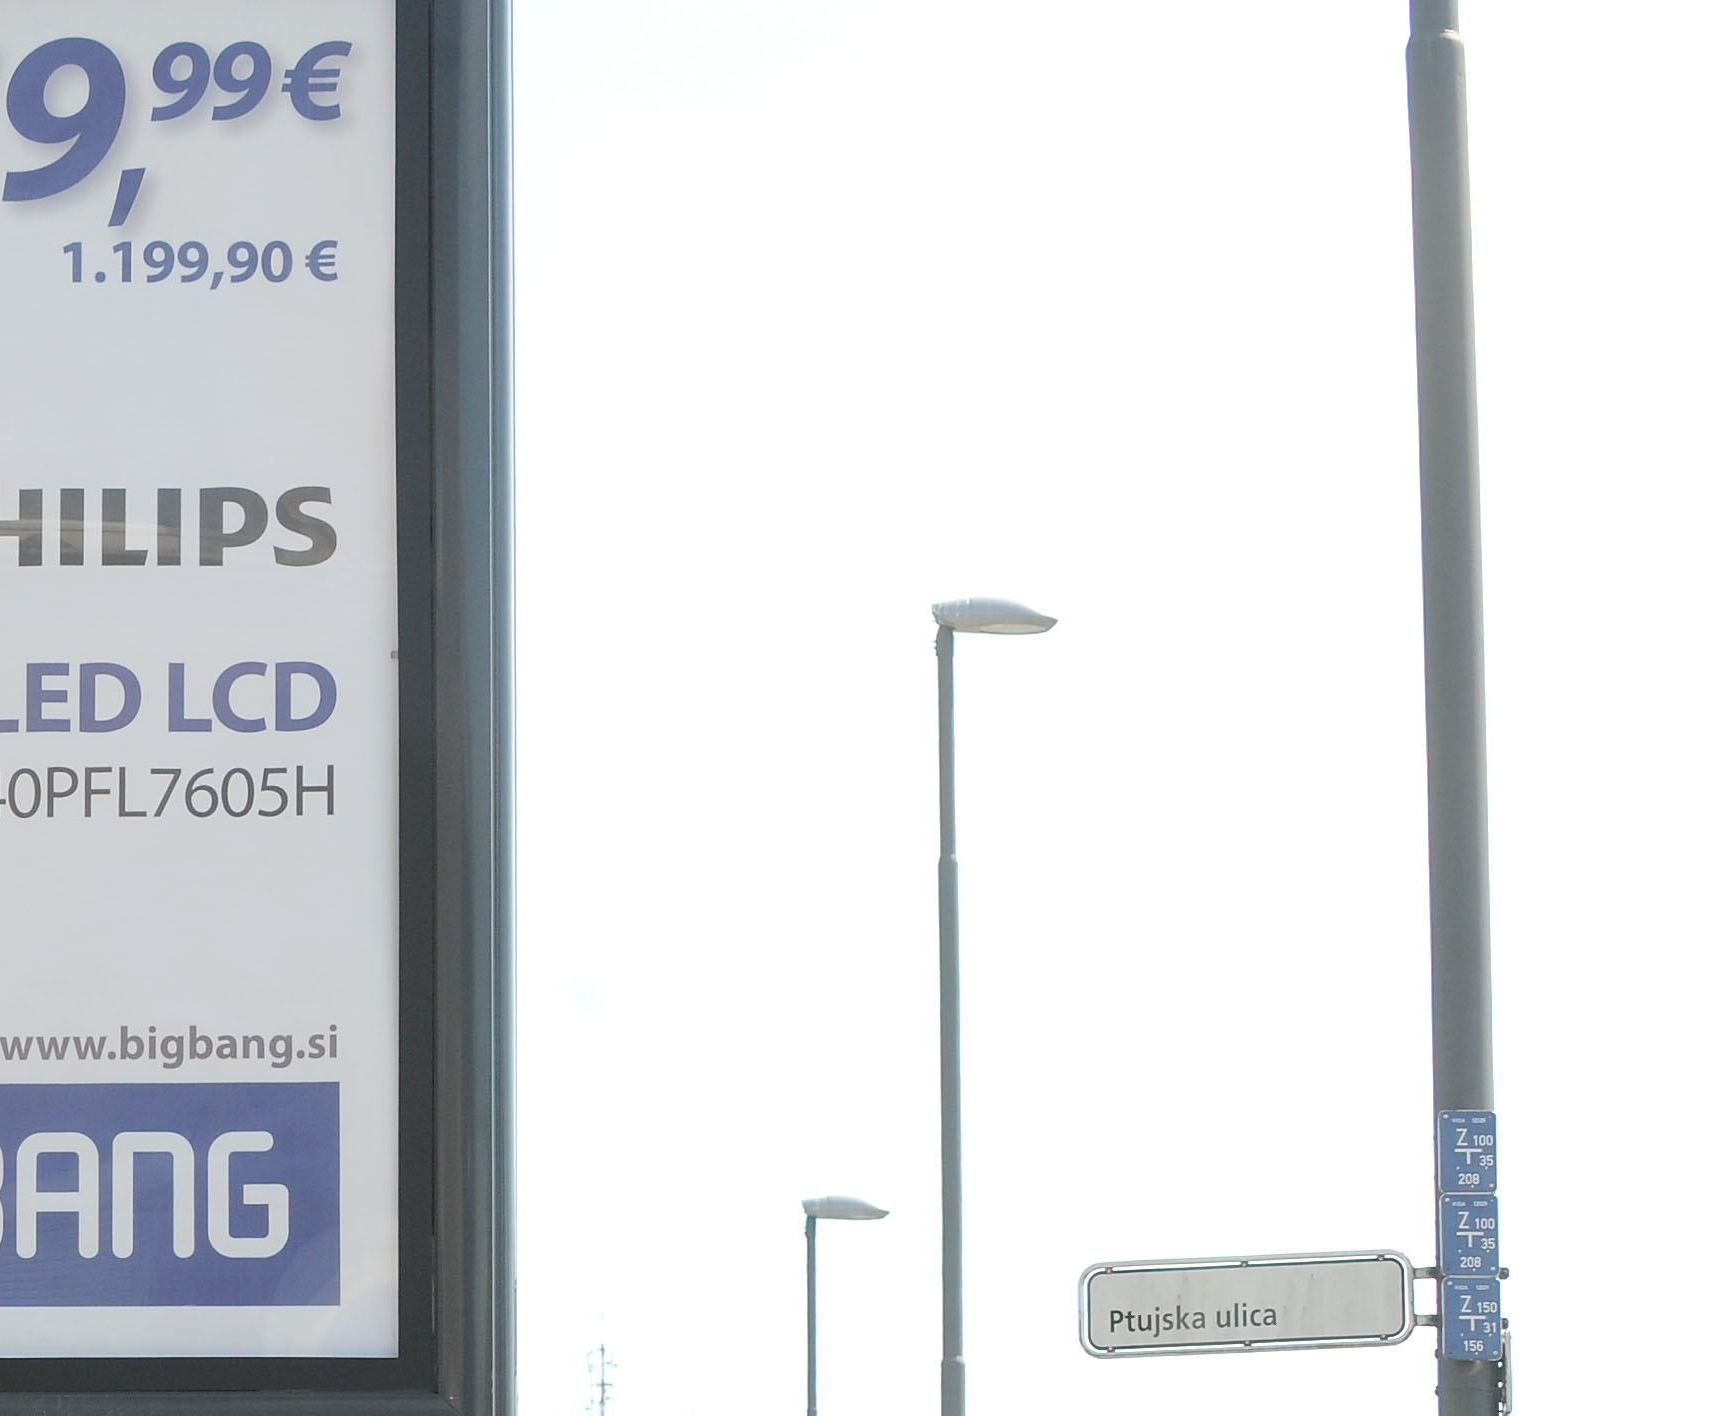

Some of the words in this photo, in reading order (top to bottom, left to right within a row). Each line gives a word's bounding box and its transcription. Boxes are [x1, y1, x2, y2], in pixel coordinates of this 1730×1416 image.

[61, 241, 294, 290] 1.199,90
[304, 241, 339, 282] €
[167, 661, 338, 734] LCD
[0, 1024, 339, 1069] www.bigbang.si
[1456, 1128, 1468, 1146] Z
[1473, 1135, 1494, 1147] 100
[1479, 1155, 1494, 1166] 35
[1458, 1173, 1480, 1185] 208
[1457, 1211, 1470, 1229] Z
[1475, 1218, 1496, 1229] 100
[1481, 1238, 1496, 1249] 35
[1460, 1256, 1482, 1268] 208
[1460, 1295, 1472, 1313] Z
[1477, 1302, 1498, 1313] 150
[1109, 1307, 1206, 1338] Ptujska
[1216, 1303, 1277, 1328] ulica
[1483, 1322, 1496, 1333] 31
[1463, 1340, 1484, 1352] 156
